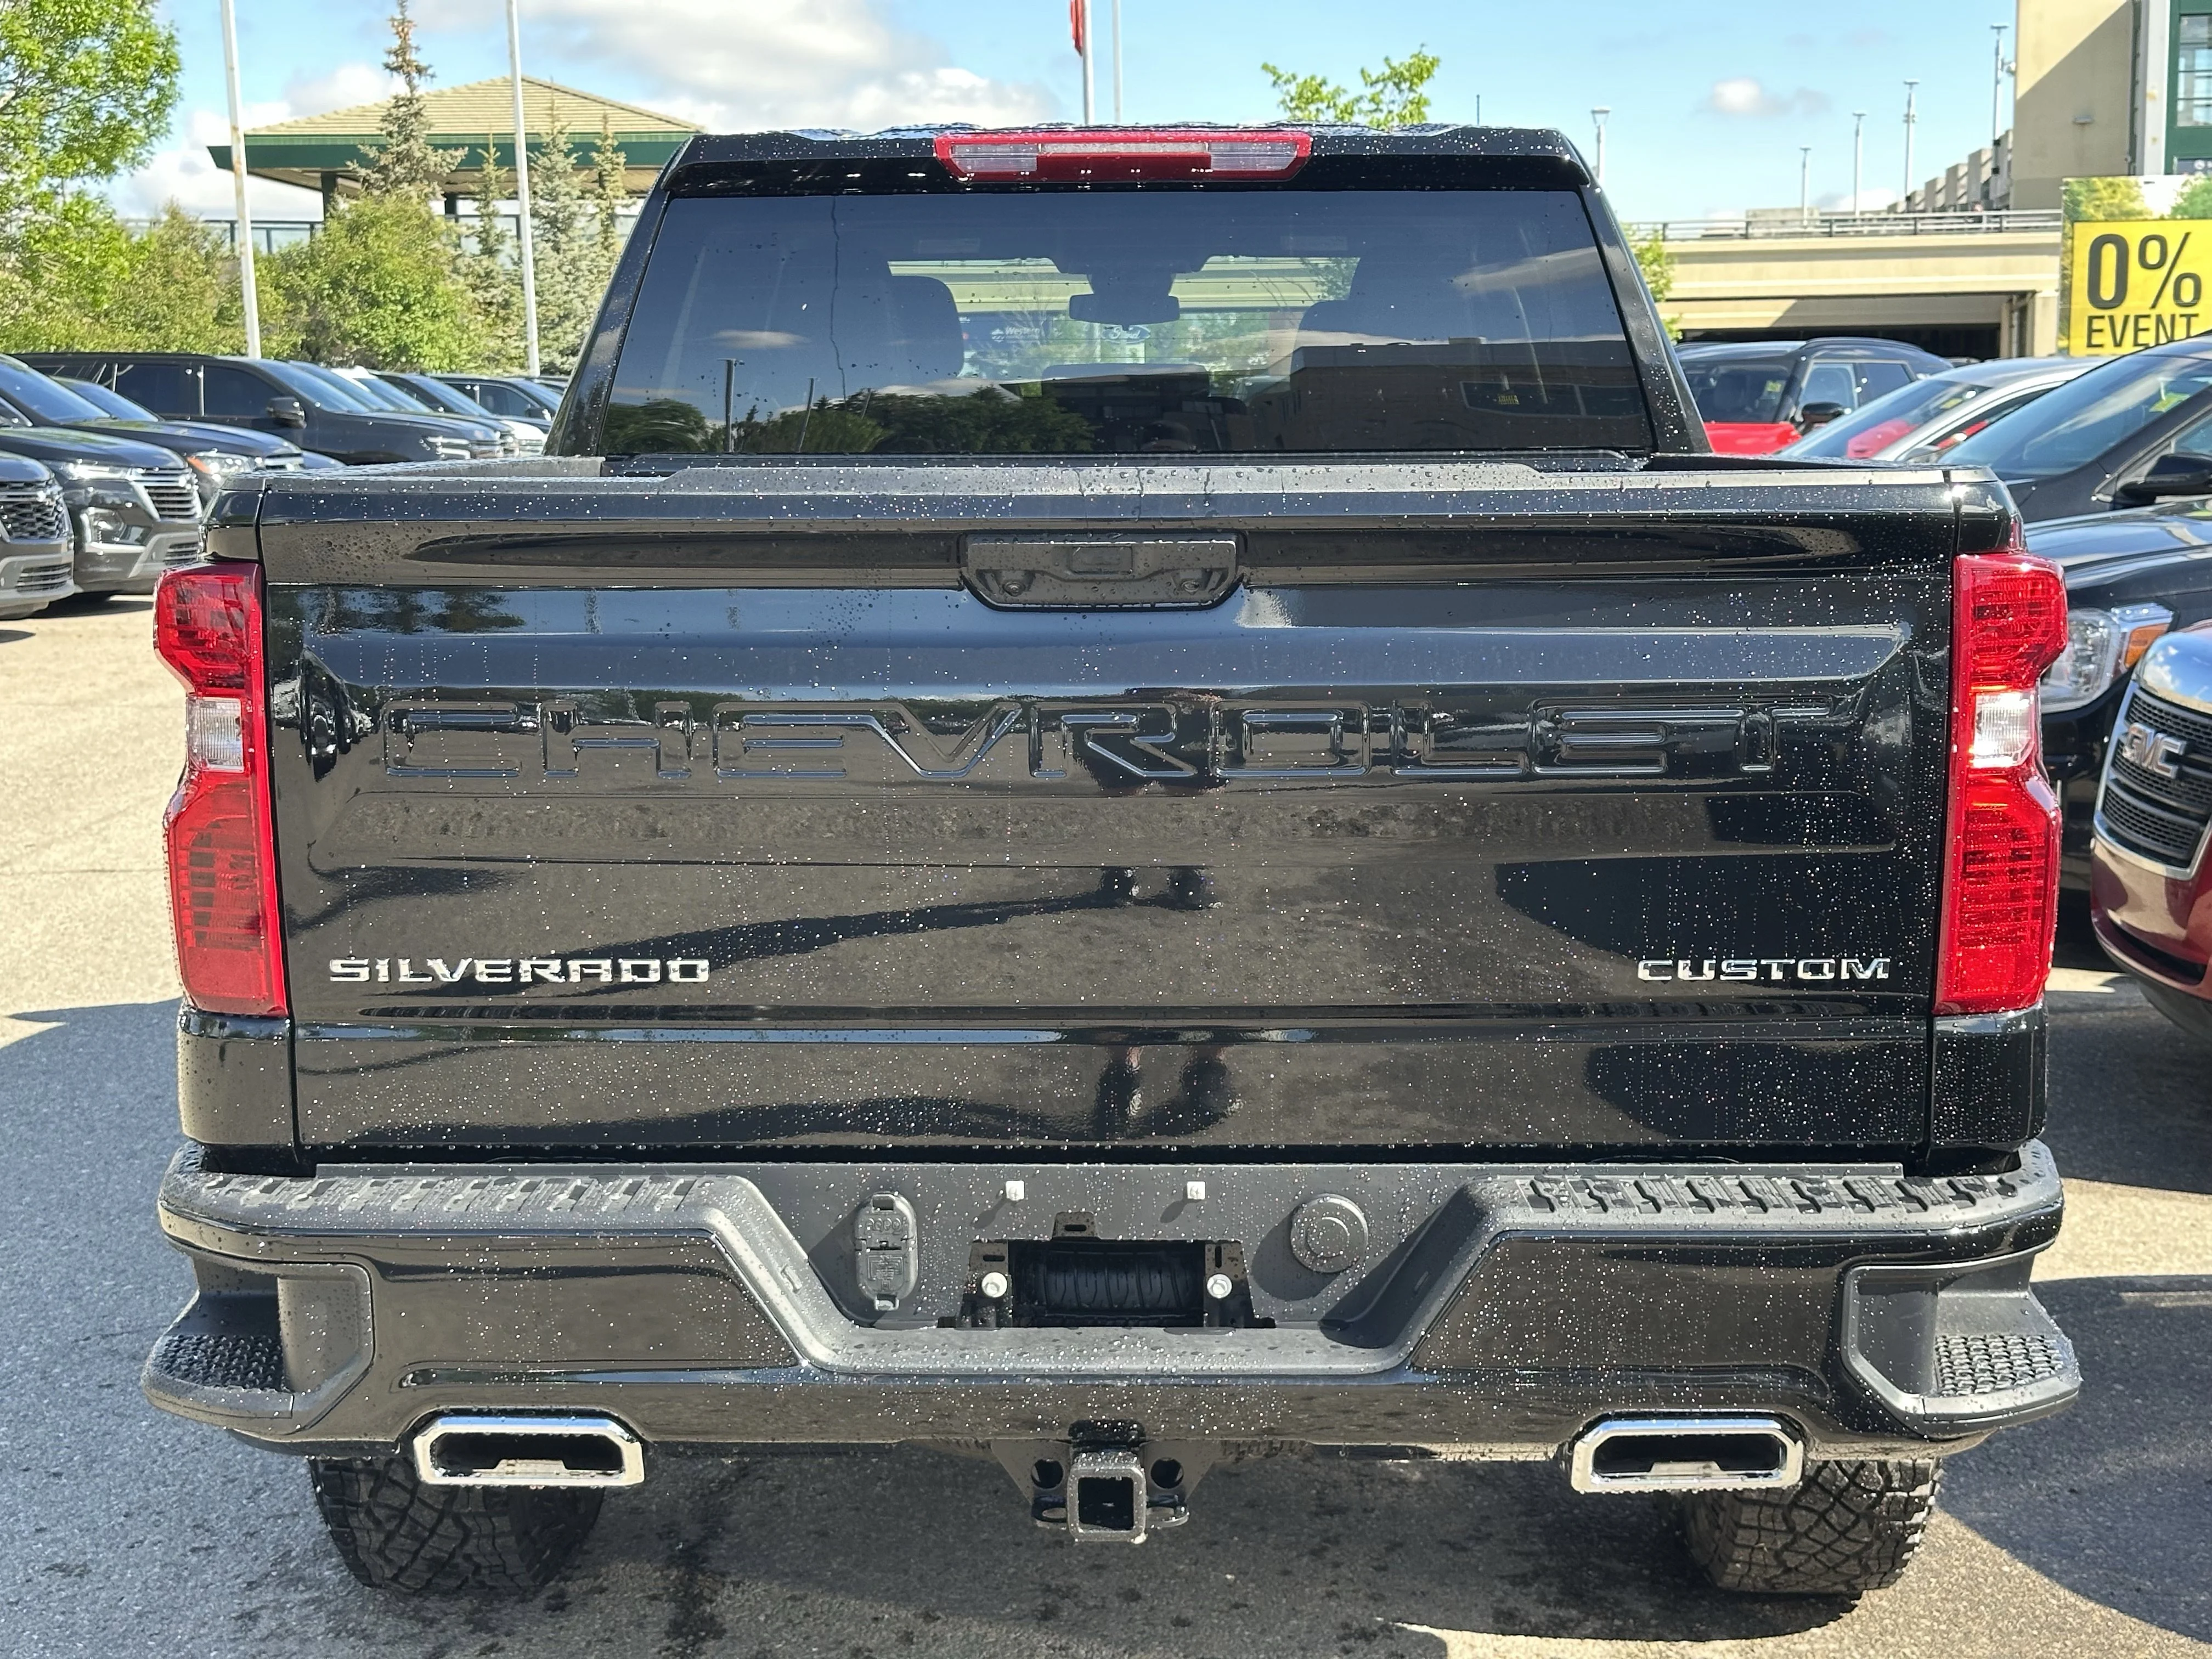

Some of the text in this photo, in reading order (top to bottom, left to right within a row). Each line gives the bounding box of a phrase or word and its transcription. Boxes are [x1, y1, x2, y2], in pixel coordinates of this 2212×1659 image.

[2087, 232, 2202, 309] 0%
[2086, 313, 2199, 348] EVENT
[382, 693, 1833, 778] CHEVROLET
[329, 957, 710, 983] SILVERADO
[1638, 957, 1891, 981] CUSTOM
